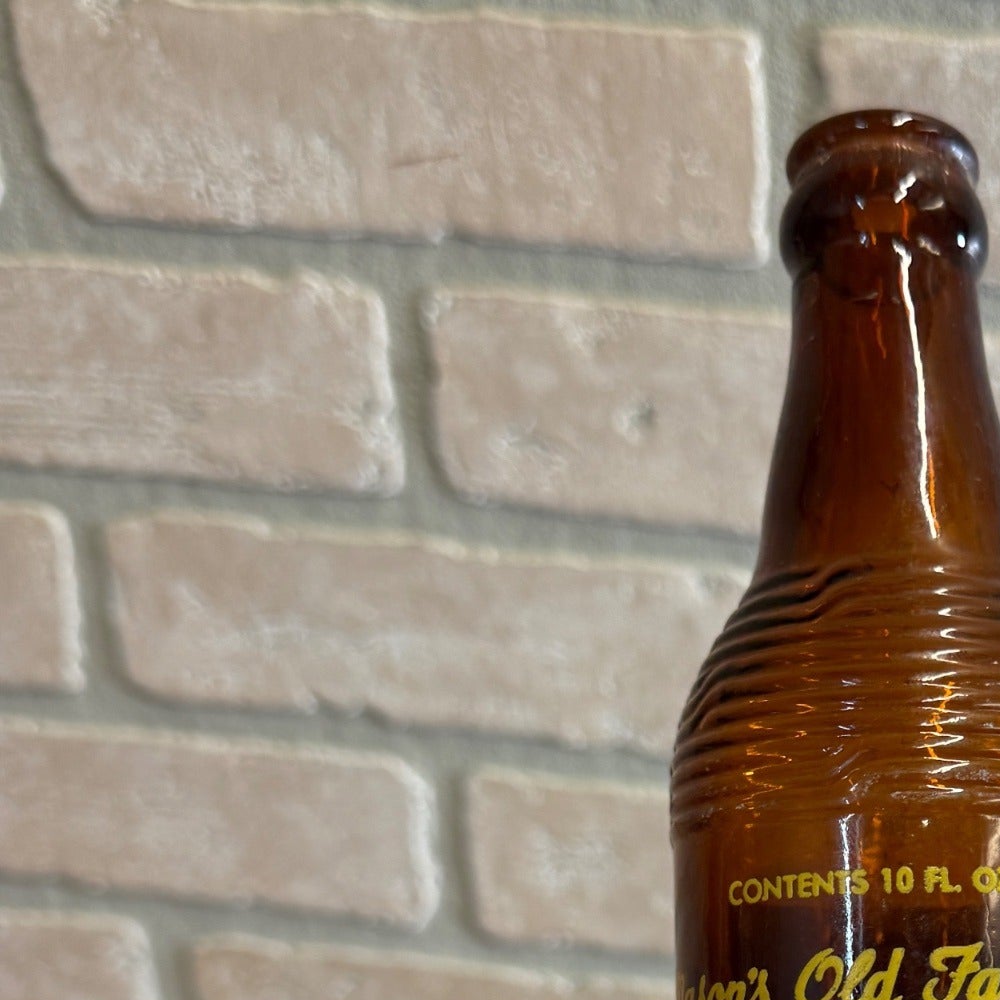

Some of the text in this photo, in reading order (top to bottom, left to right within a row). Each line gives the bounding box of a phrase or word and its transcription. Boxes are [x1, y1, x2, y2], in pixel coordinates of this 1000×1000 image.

[729, 868, 869, 906] CONTENTS
[881, 865, 914, 894] 10
[924, 866, 962, 893] FL.
